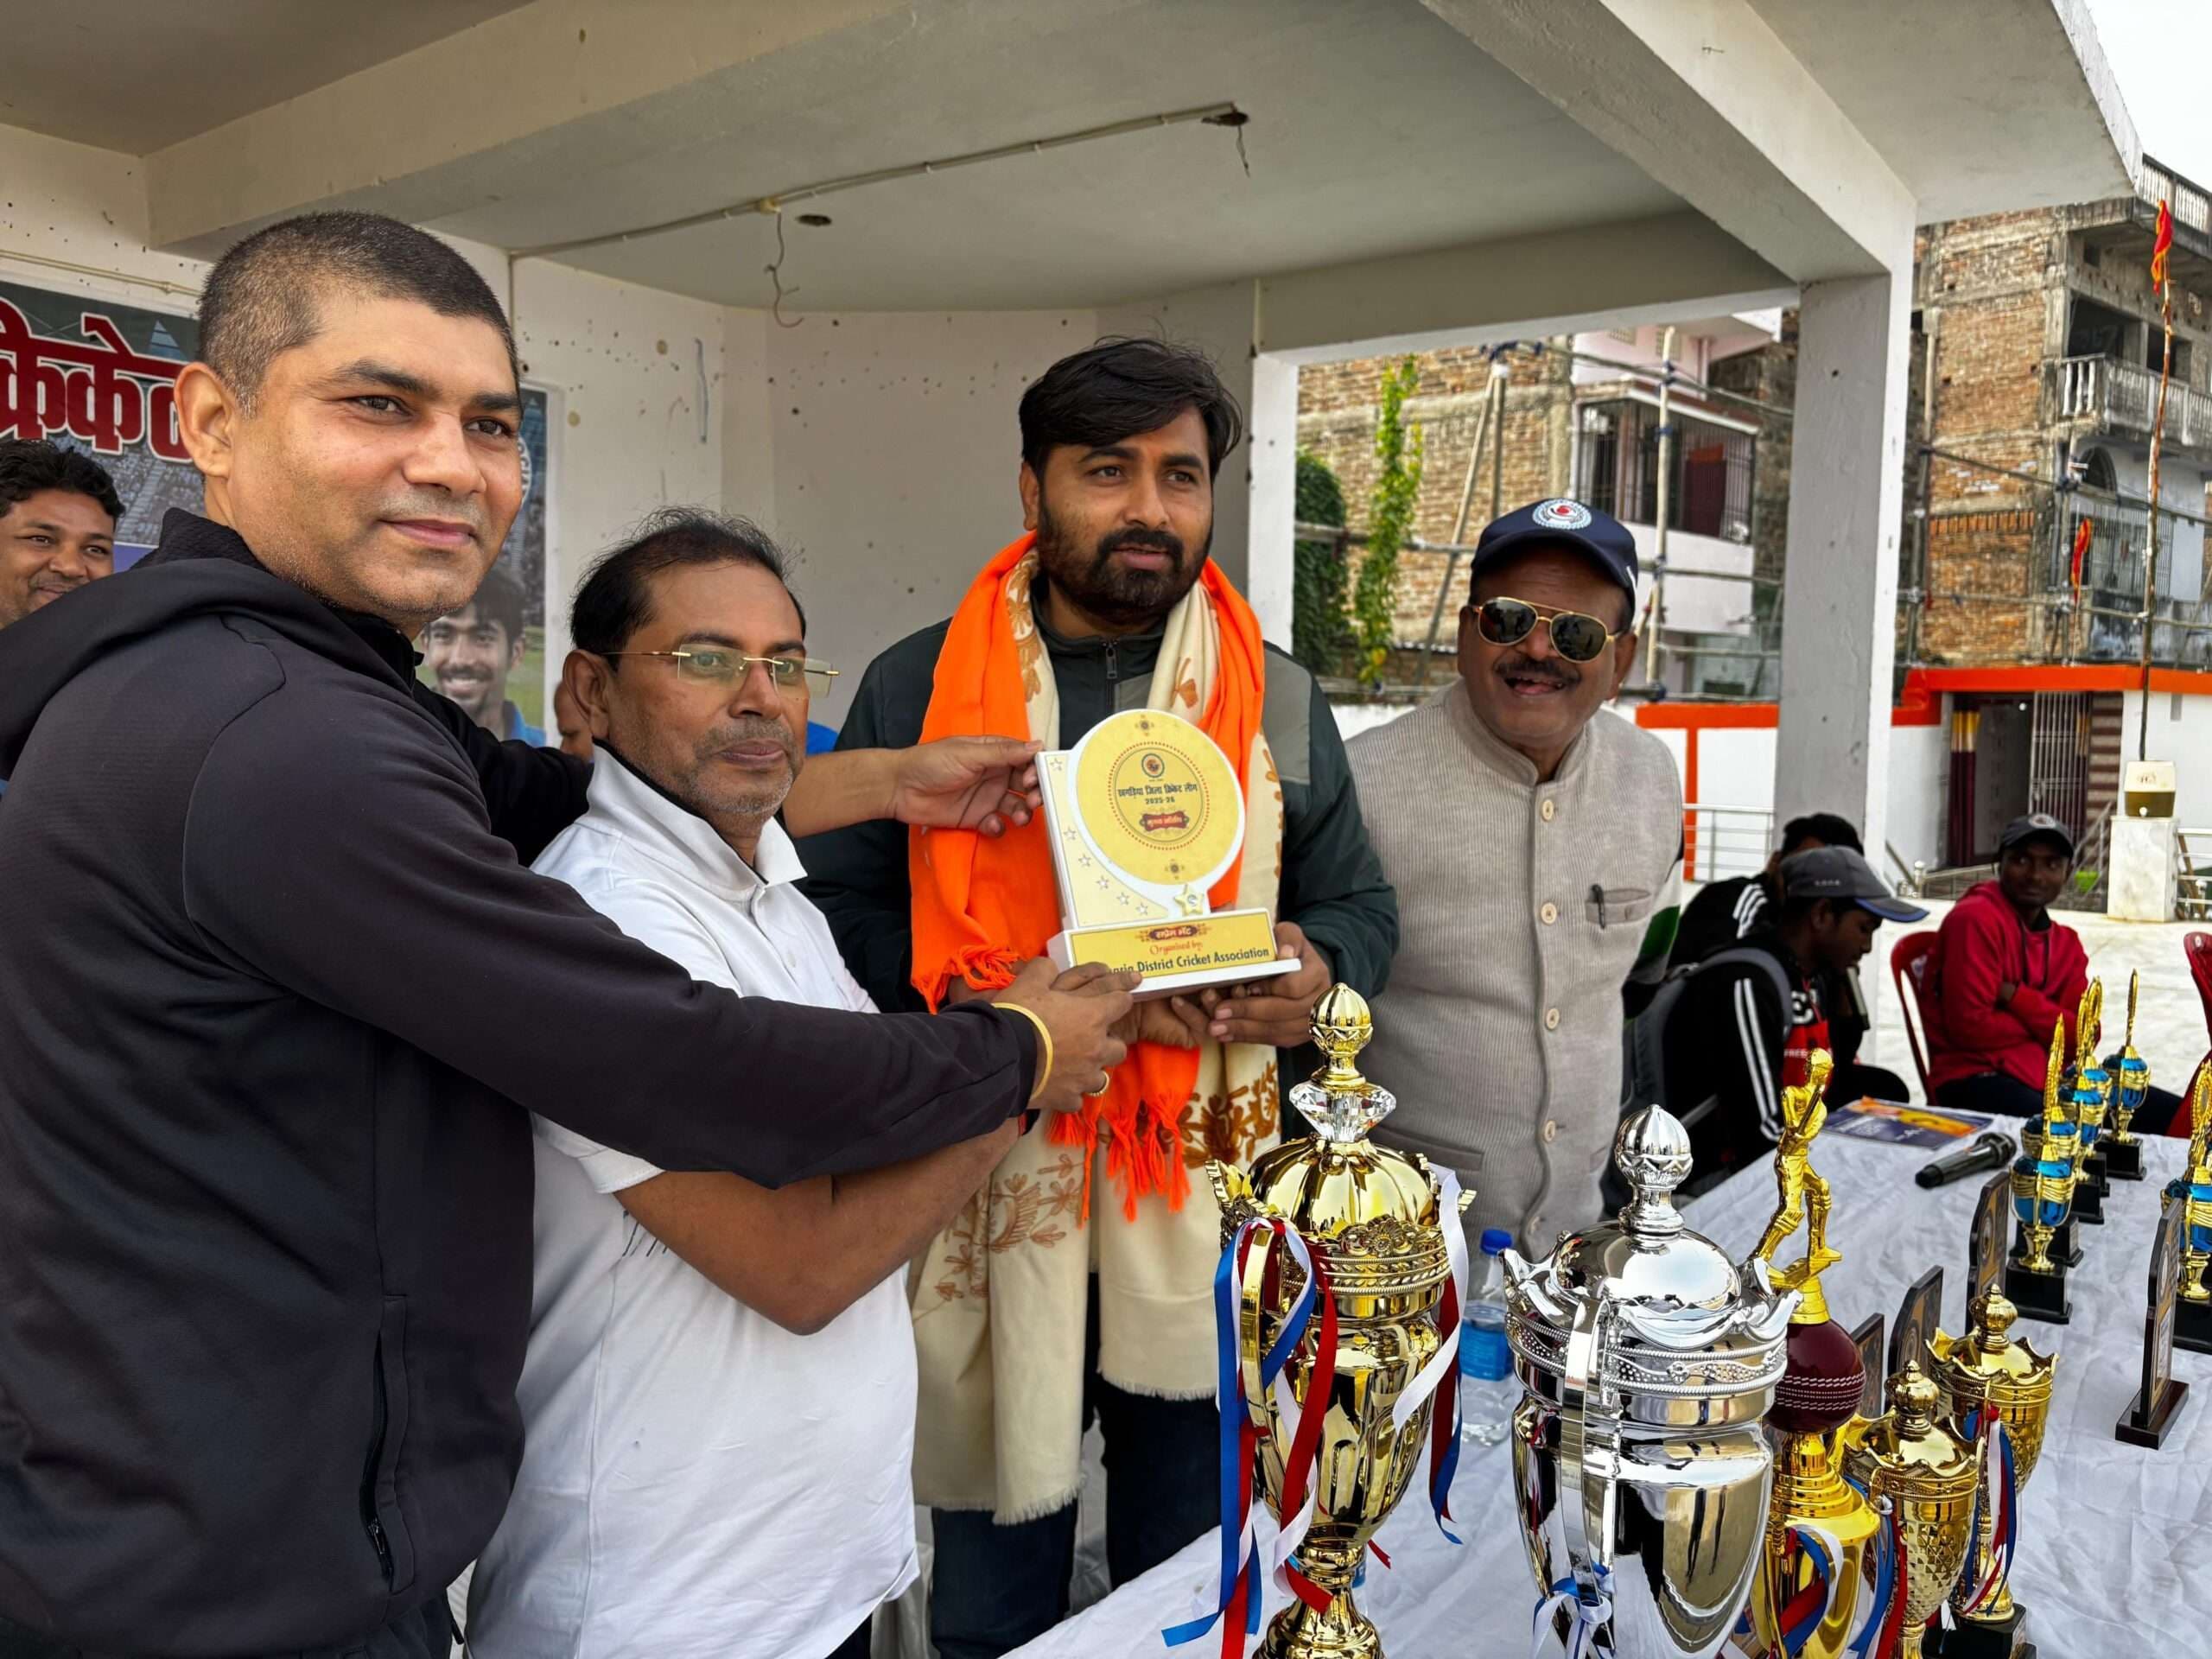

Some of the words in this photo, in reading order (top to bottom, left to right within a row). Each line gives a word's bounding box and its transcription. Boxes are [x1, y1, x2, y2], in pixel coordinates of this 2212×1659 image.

[1137, 958, 1174, 973] District
[1176, 955, 1211, 968] Cricket
[1213, 947, 1269, 963] Association
